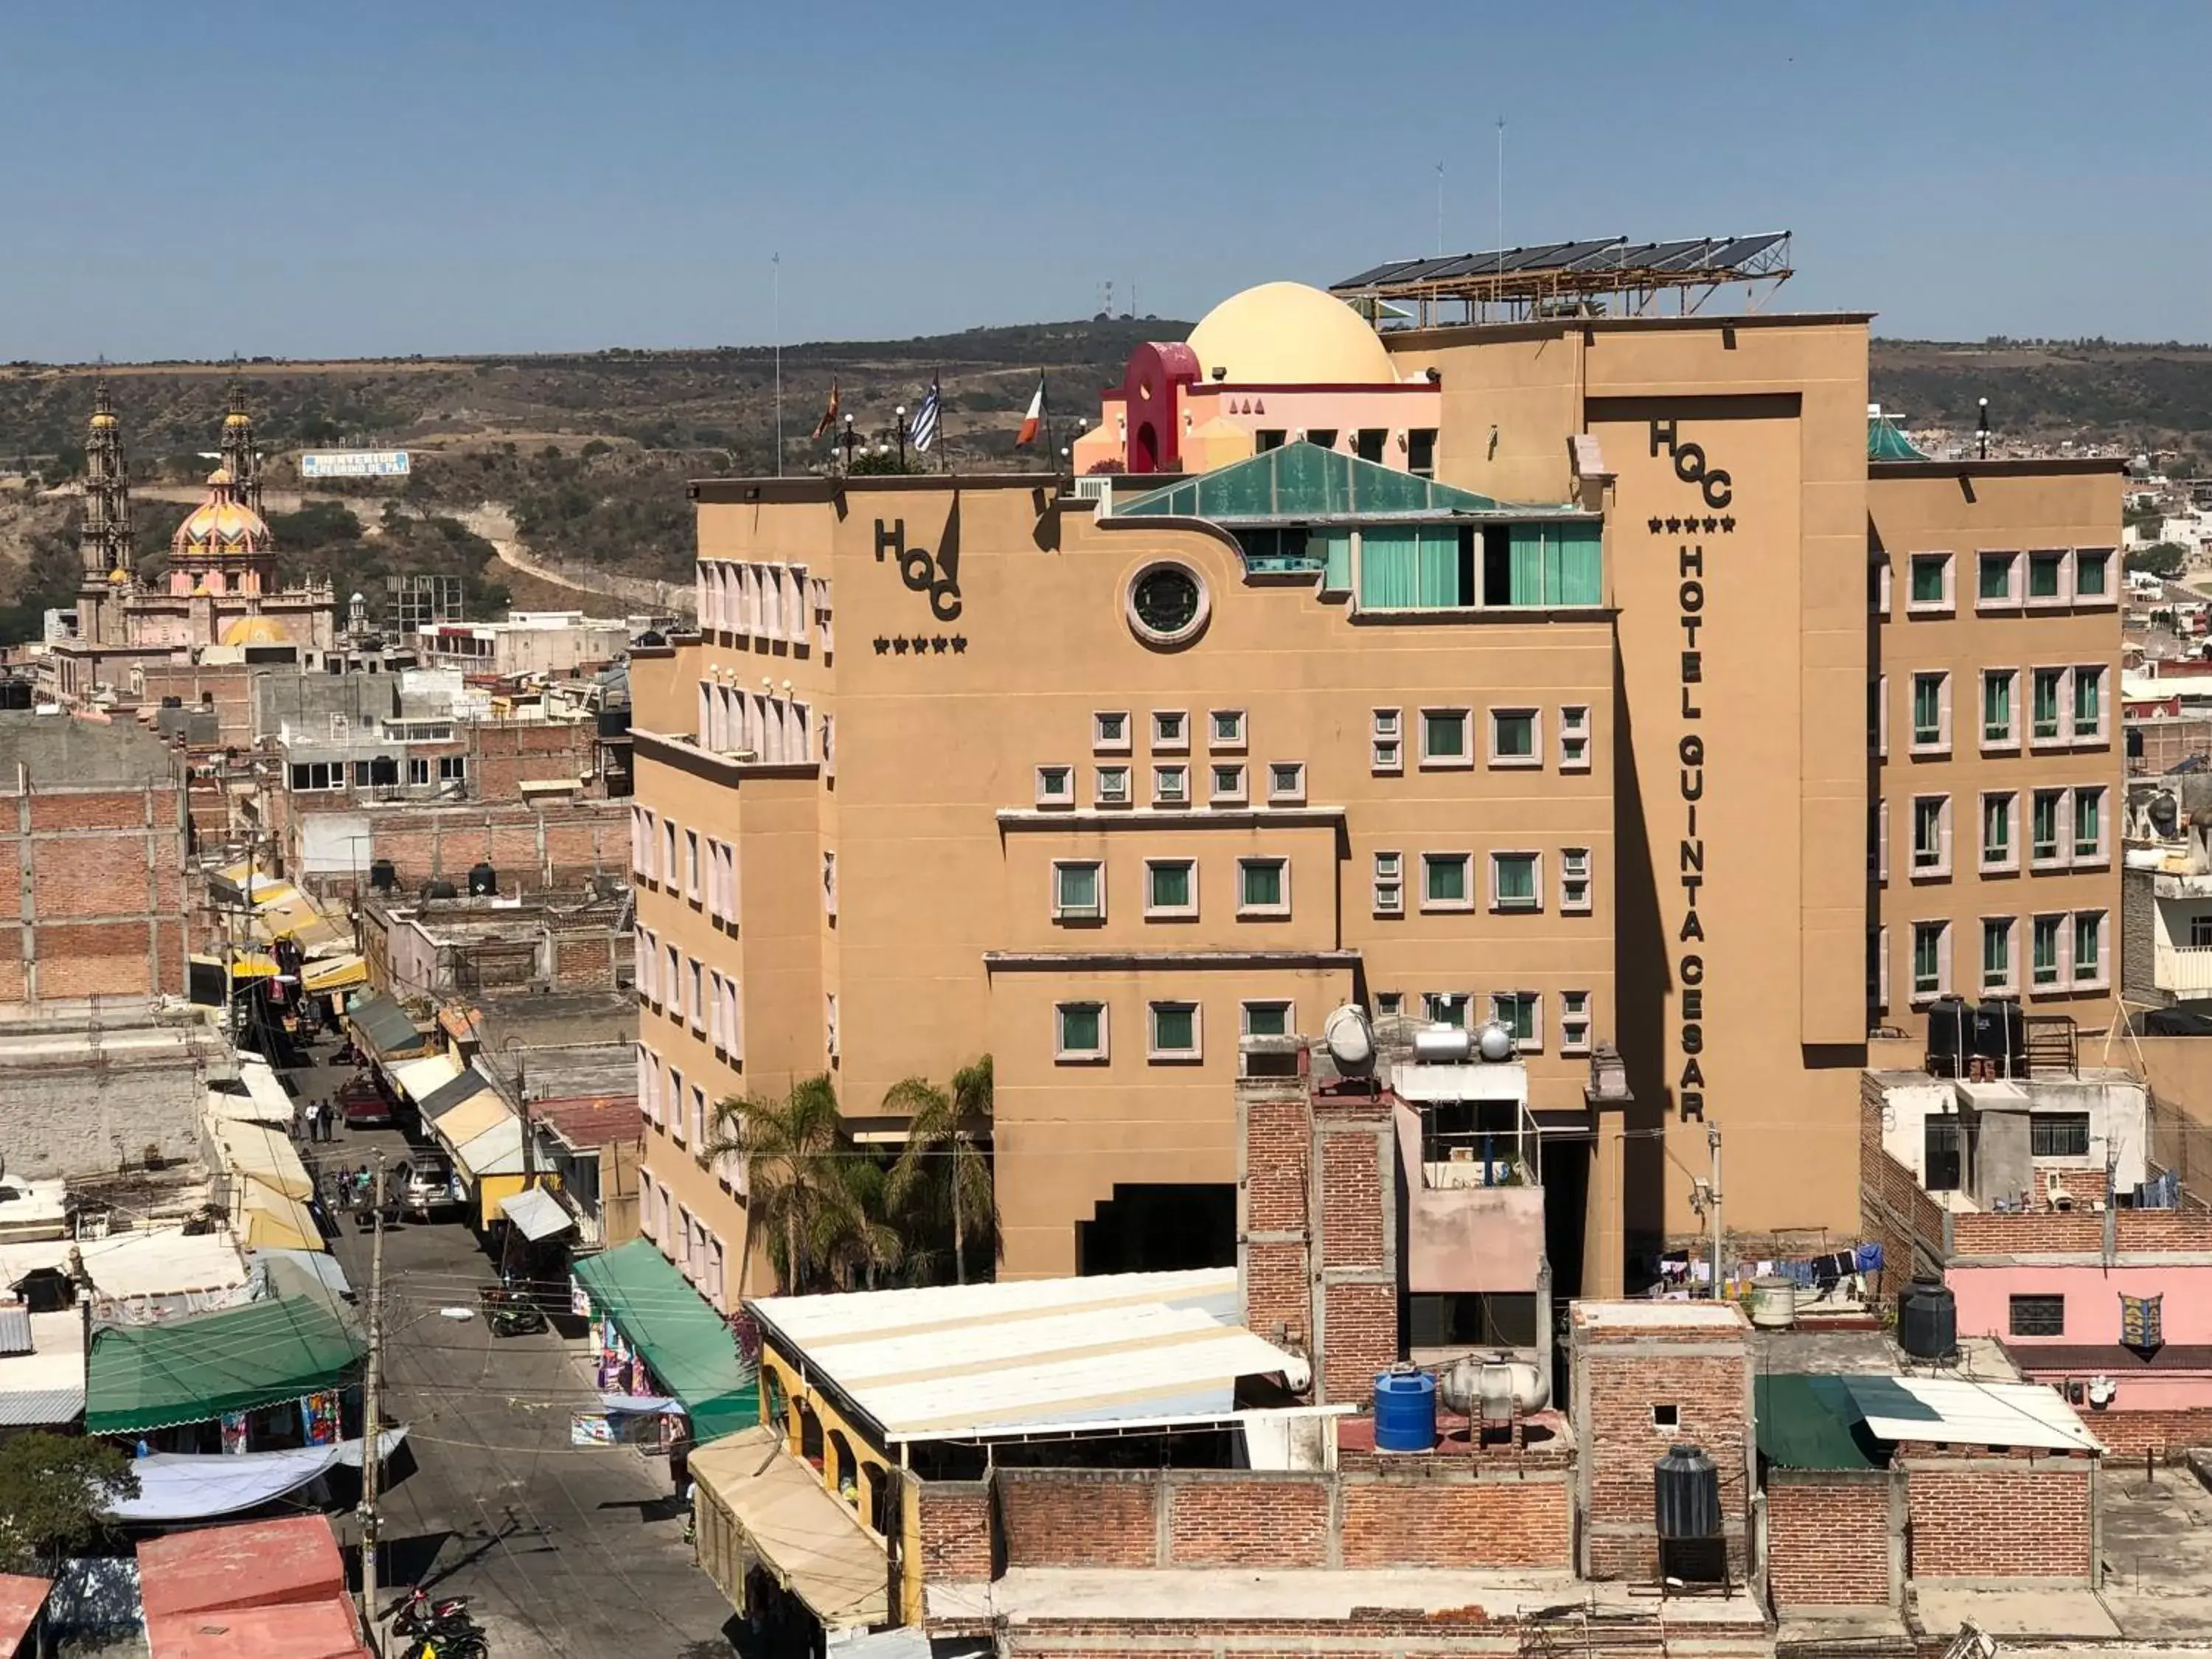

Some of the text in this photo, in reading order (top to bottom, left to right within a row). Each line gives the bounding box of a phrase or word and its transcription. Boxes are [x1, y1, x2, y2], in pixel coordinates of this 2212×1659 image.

[1649, 418, 1733, 509] HQC
[874, 518, 962, 622] HQC
[1679, 545, 1705, 1123] HOTEL QUINTA CESAR
